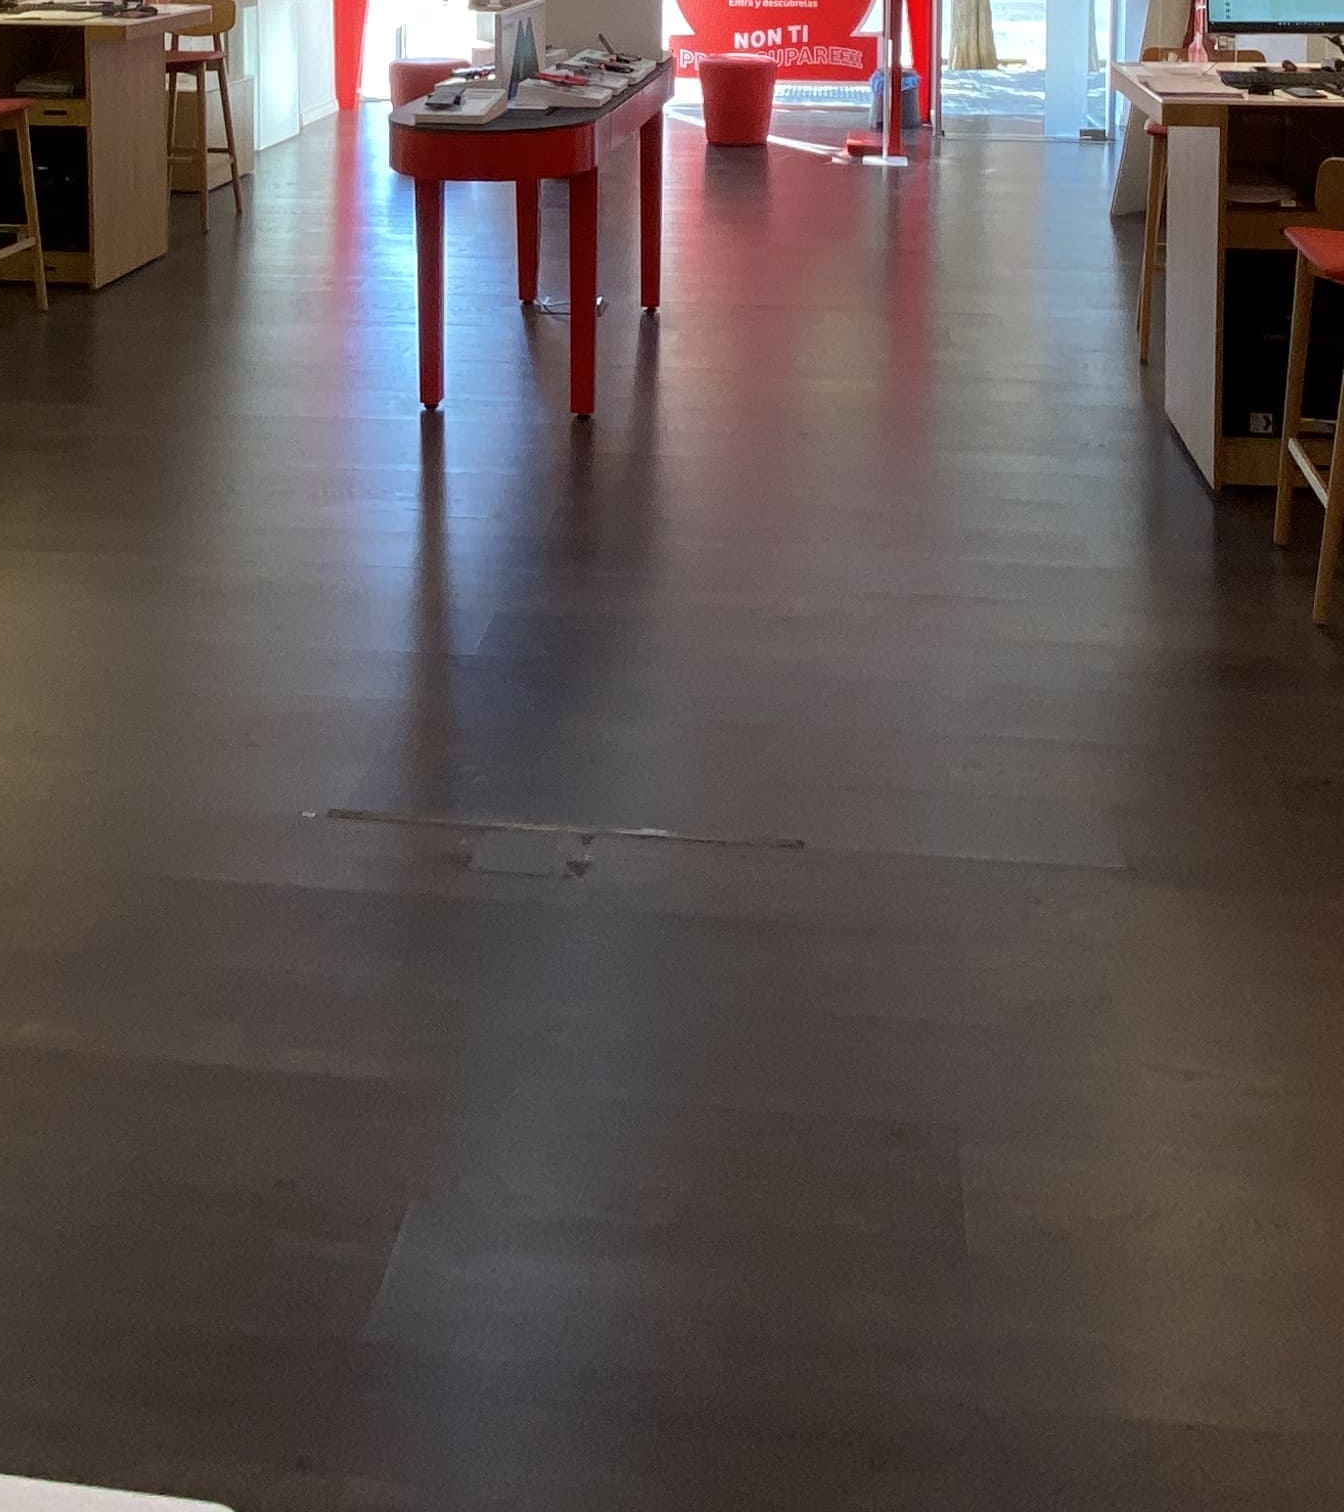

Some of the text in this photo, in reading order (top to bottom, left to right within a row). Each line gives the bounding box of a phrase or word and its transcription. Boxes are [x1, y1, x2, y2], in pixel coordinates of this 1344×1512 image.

[755, 0, 762, 9] y
[734, 25, 809, 49] NON TI
